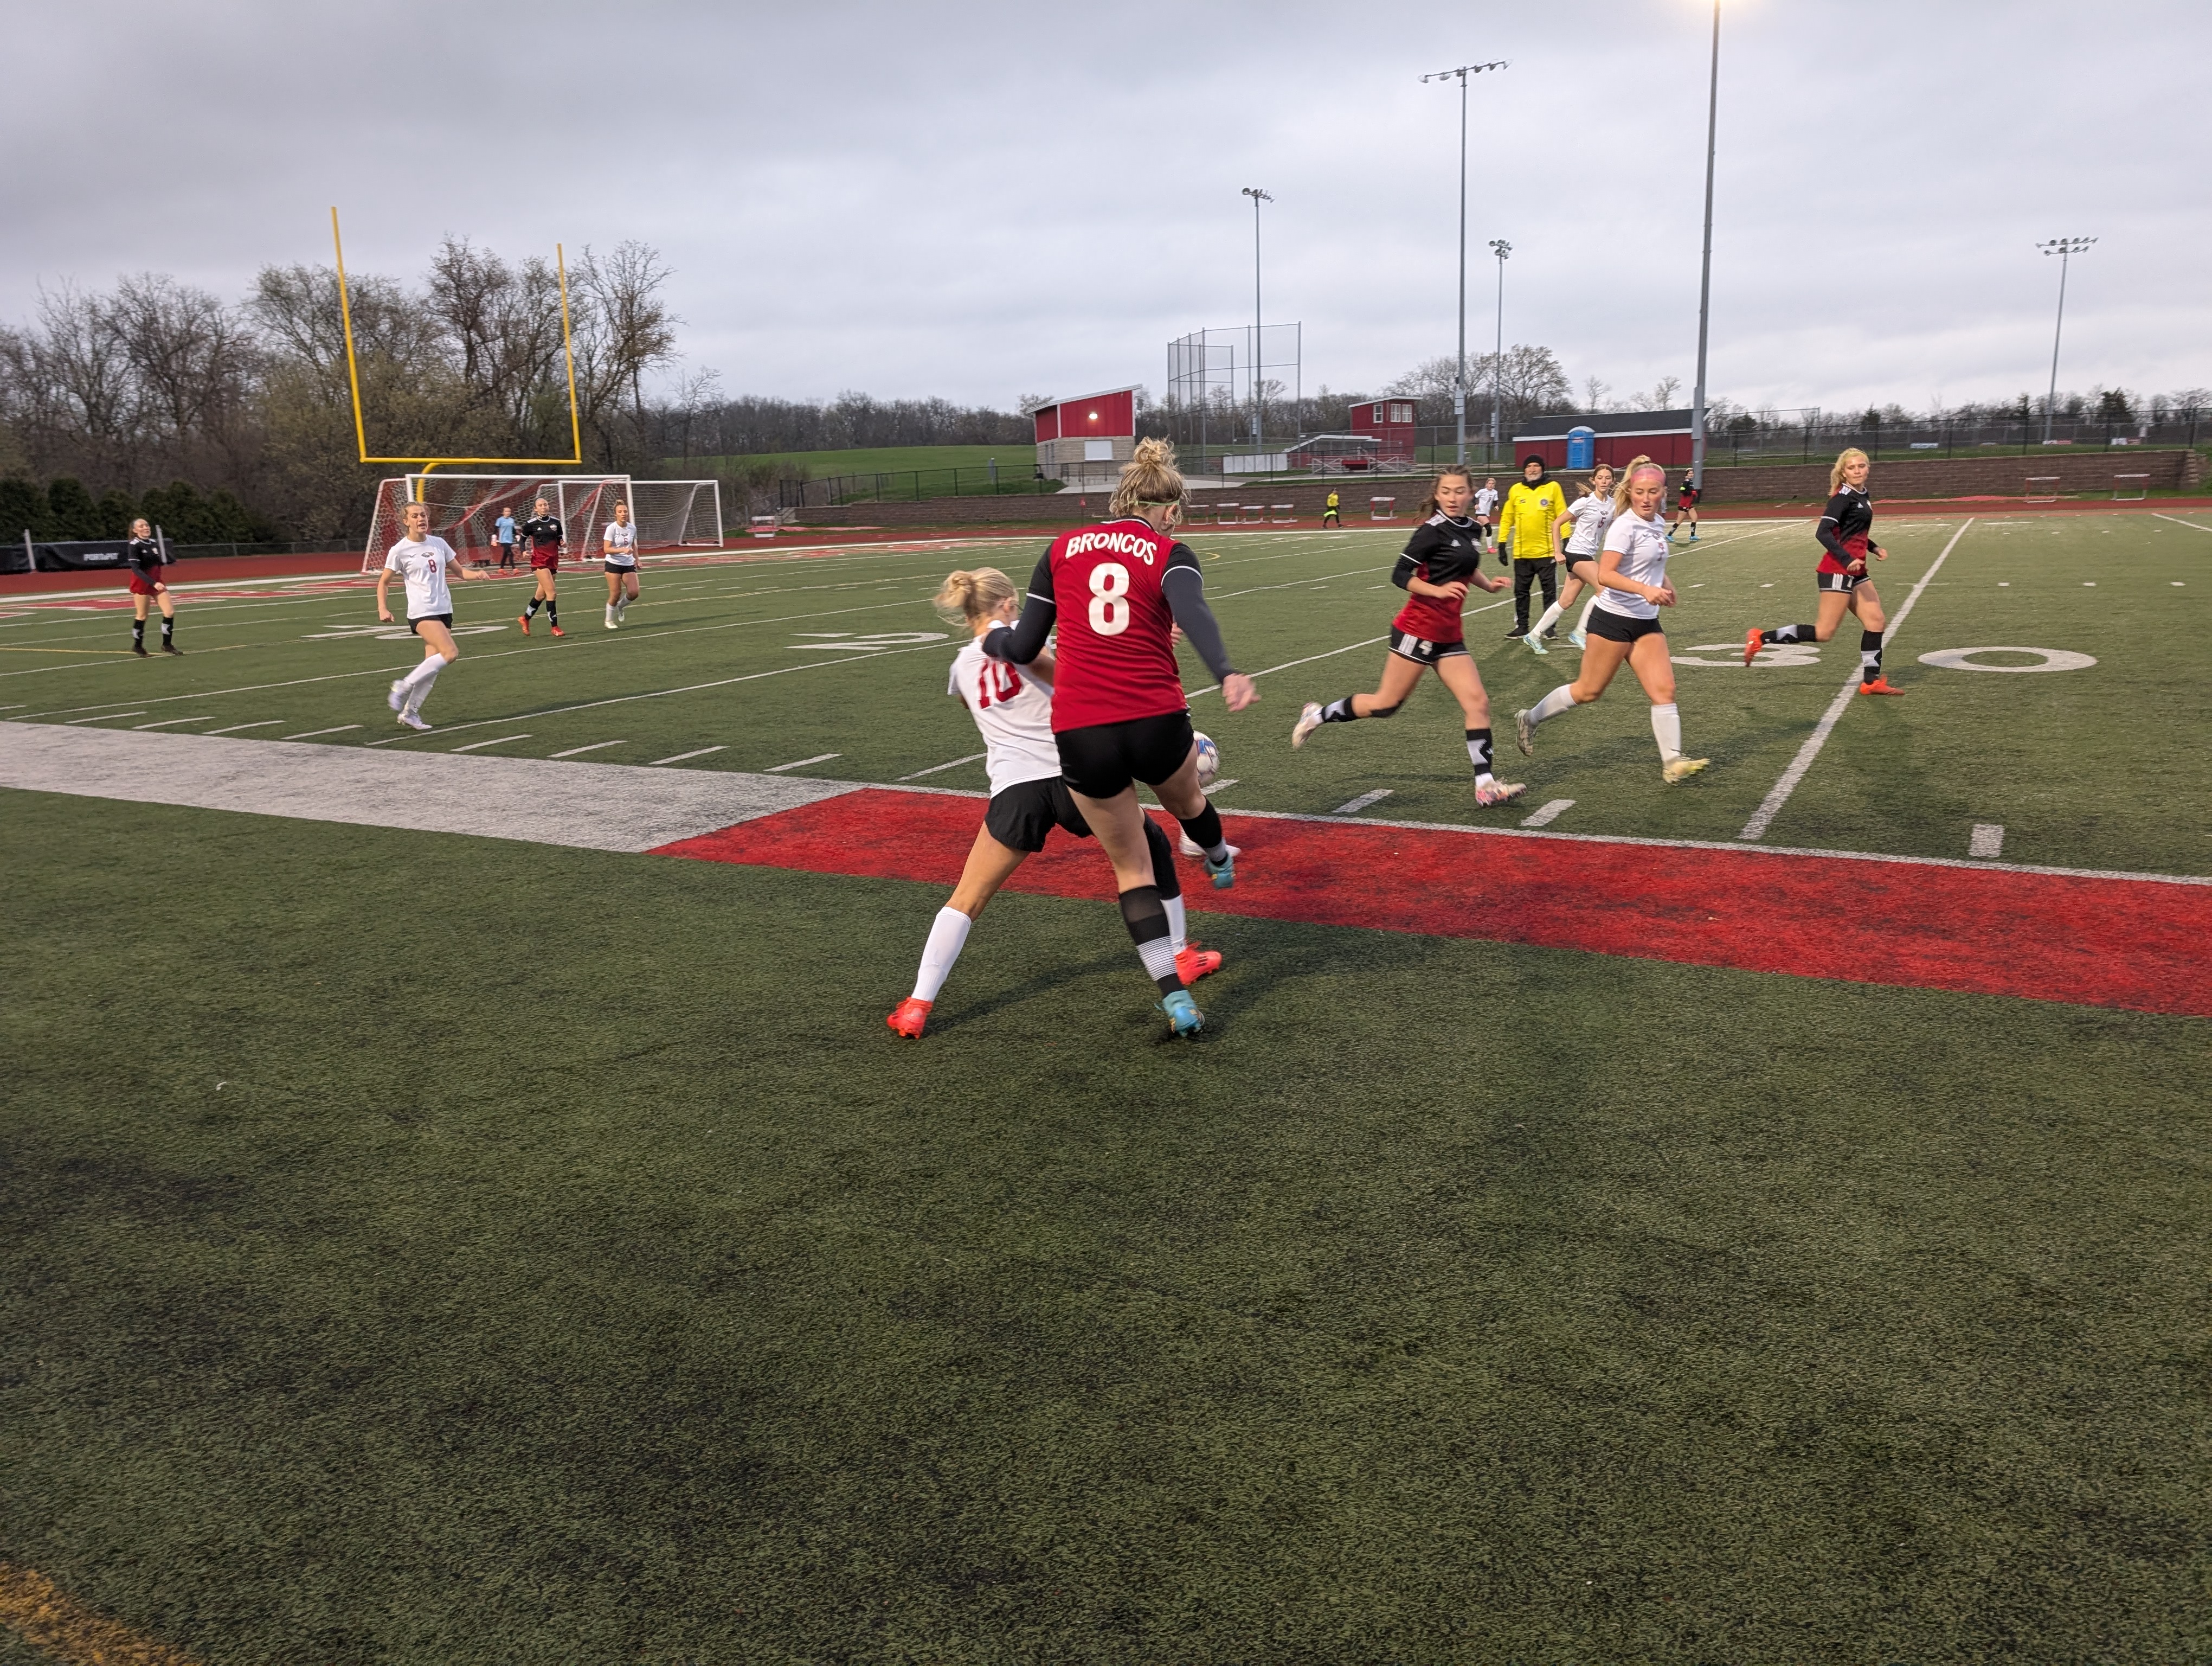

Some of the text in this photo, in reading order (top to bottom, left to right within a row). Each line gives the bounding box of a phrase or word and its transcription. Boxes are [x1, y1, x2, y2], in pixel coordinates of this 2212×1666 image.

[1598, 517, 1606, 528] 5
[1065, 533, 1157, 565] BRONCOS
[428, 559, 437, 573] 8
[1089, 562, 1130, 636] 8
[1418, 640, 1433, 655] 4
[979, 656, 1022, 709] 10
